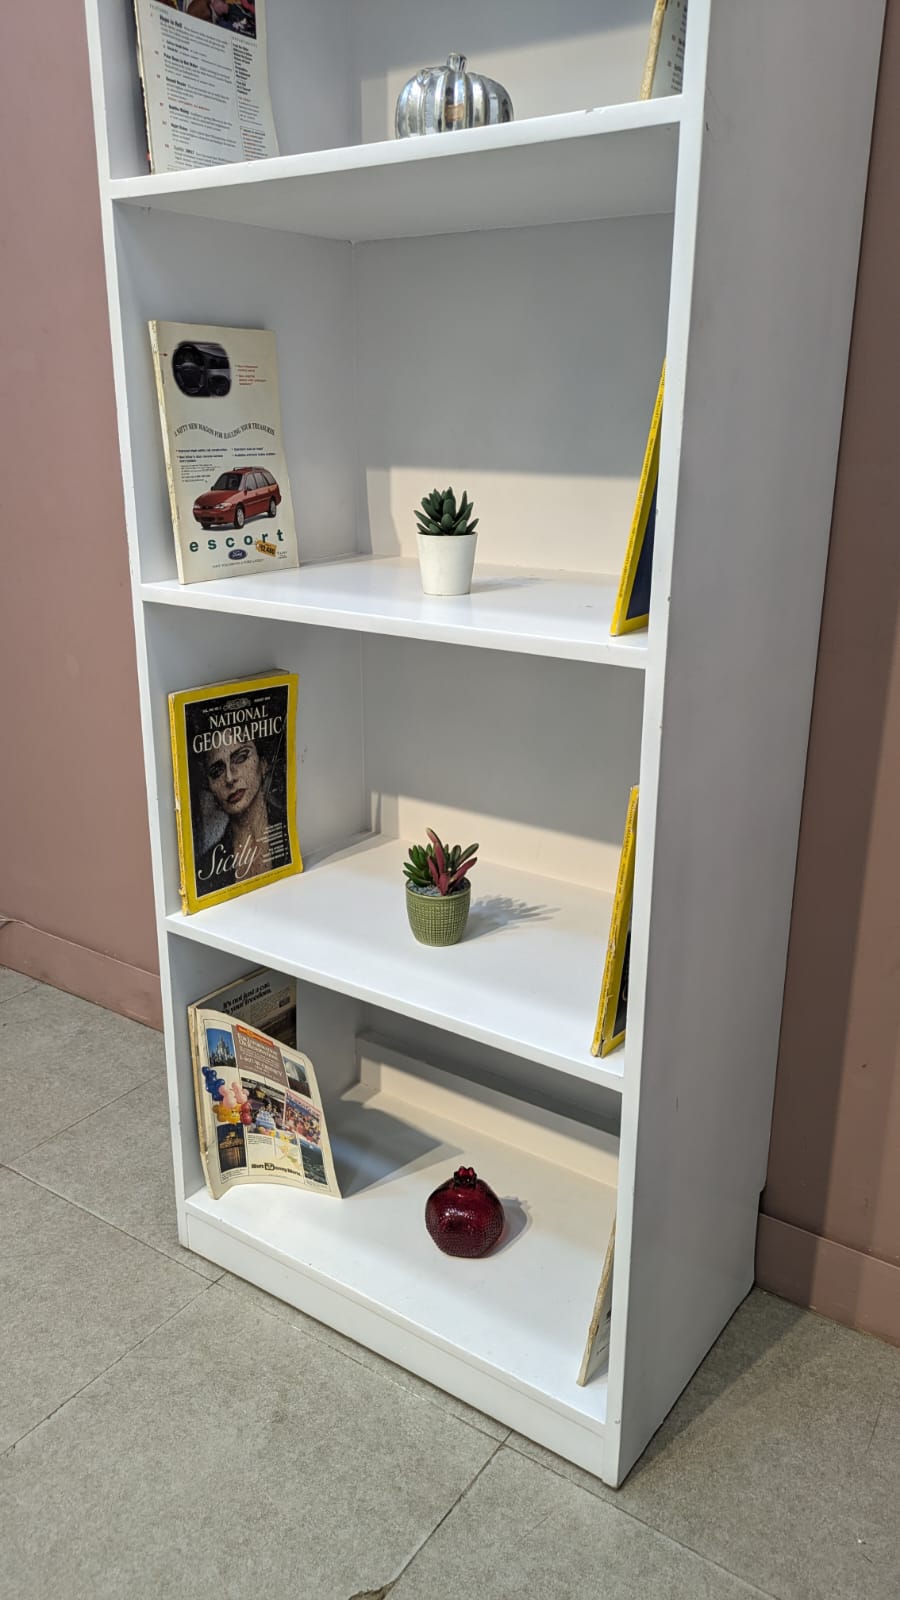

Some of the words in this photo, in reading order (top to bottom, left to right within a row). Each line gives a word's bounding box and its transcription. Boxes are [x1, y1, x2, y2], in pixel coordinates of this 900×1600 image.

[189, 529, 284, 553] escort
[209, 704, 268, 729] NATIONAL
[192, 716, 283, 754] GEOGRAPHIC
[197, 834, 257, 880] Sicily
